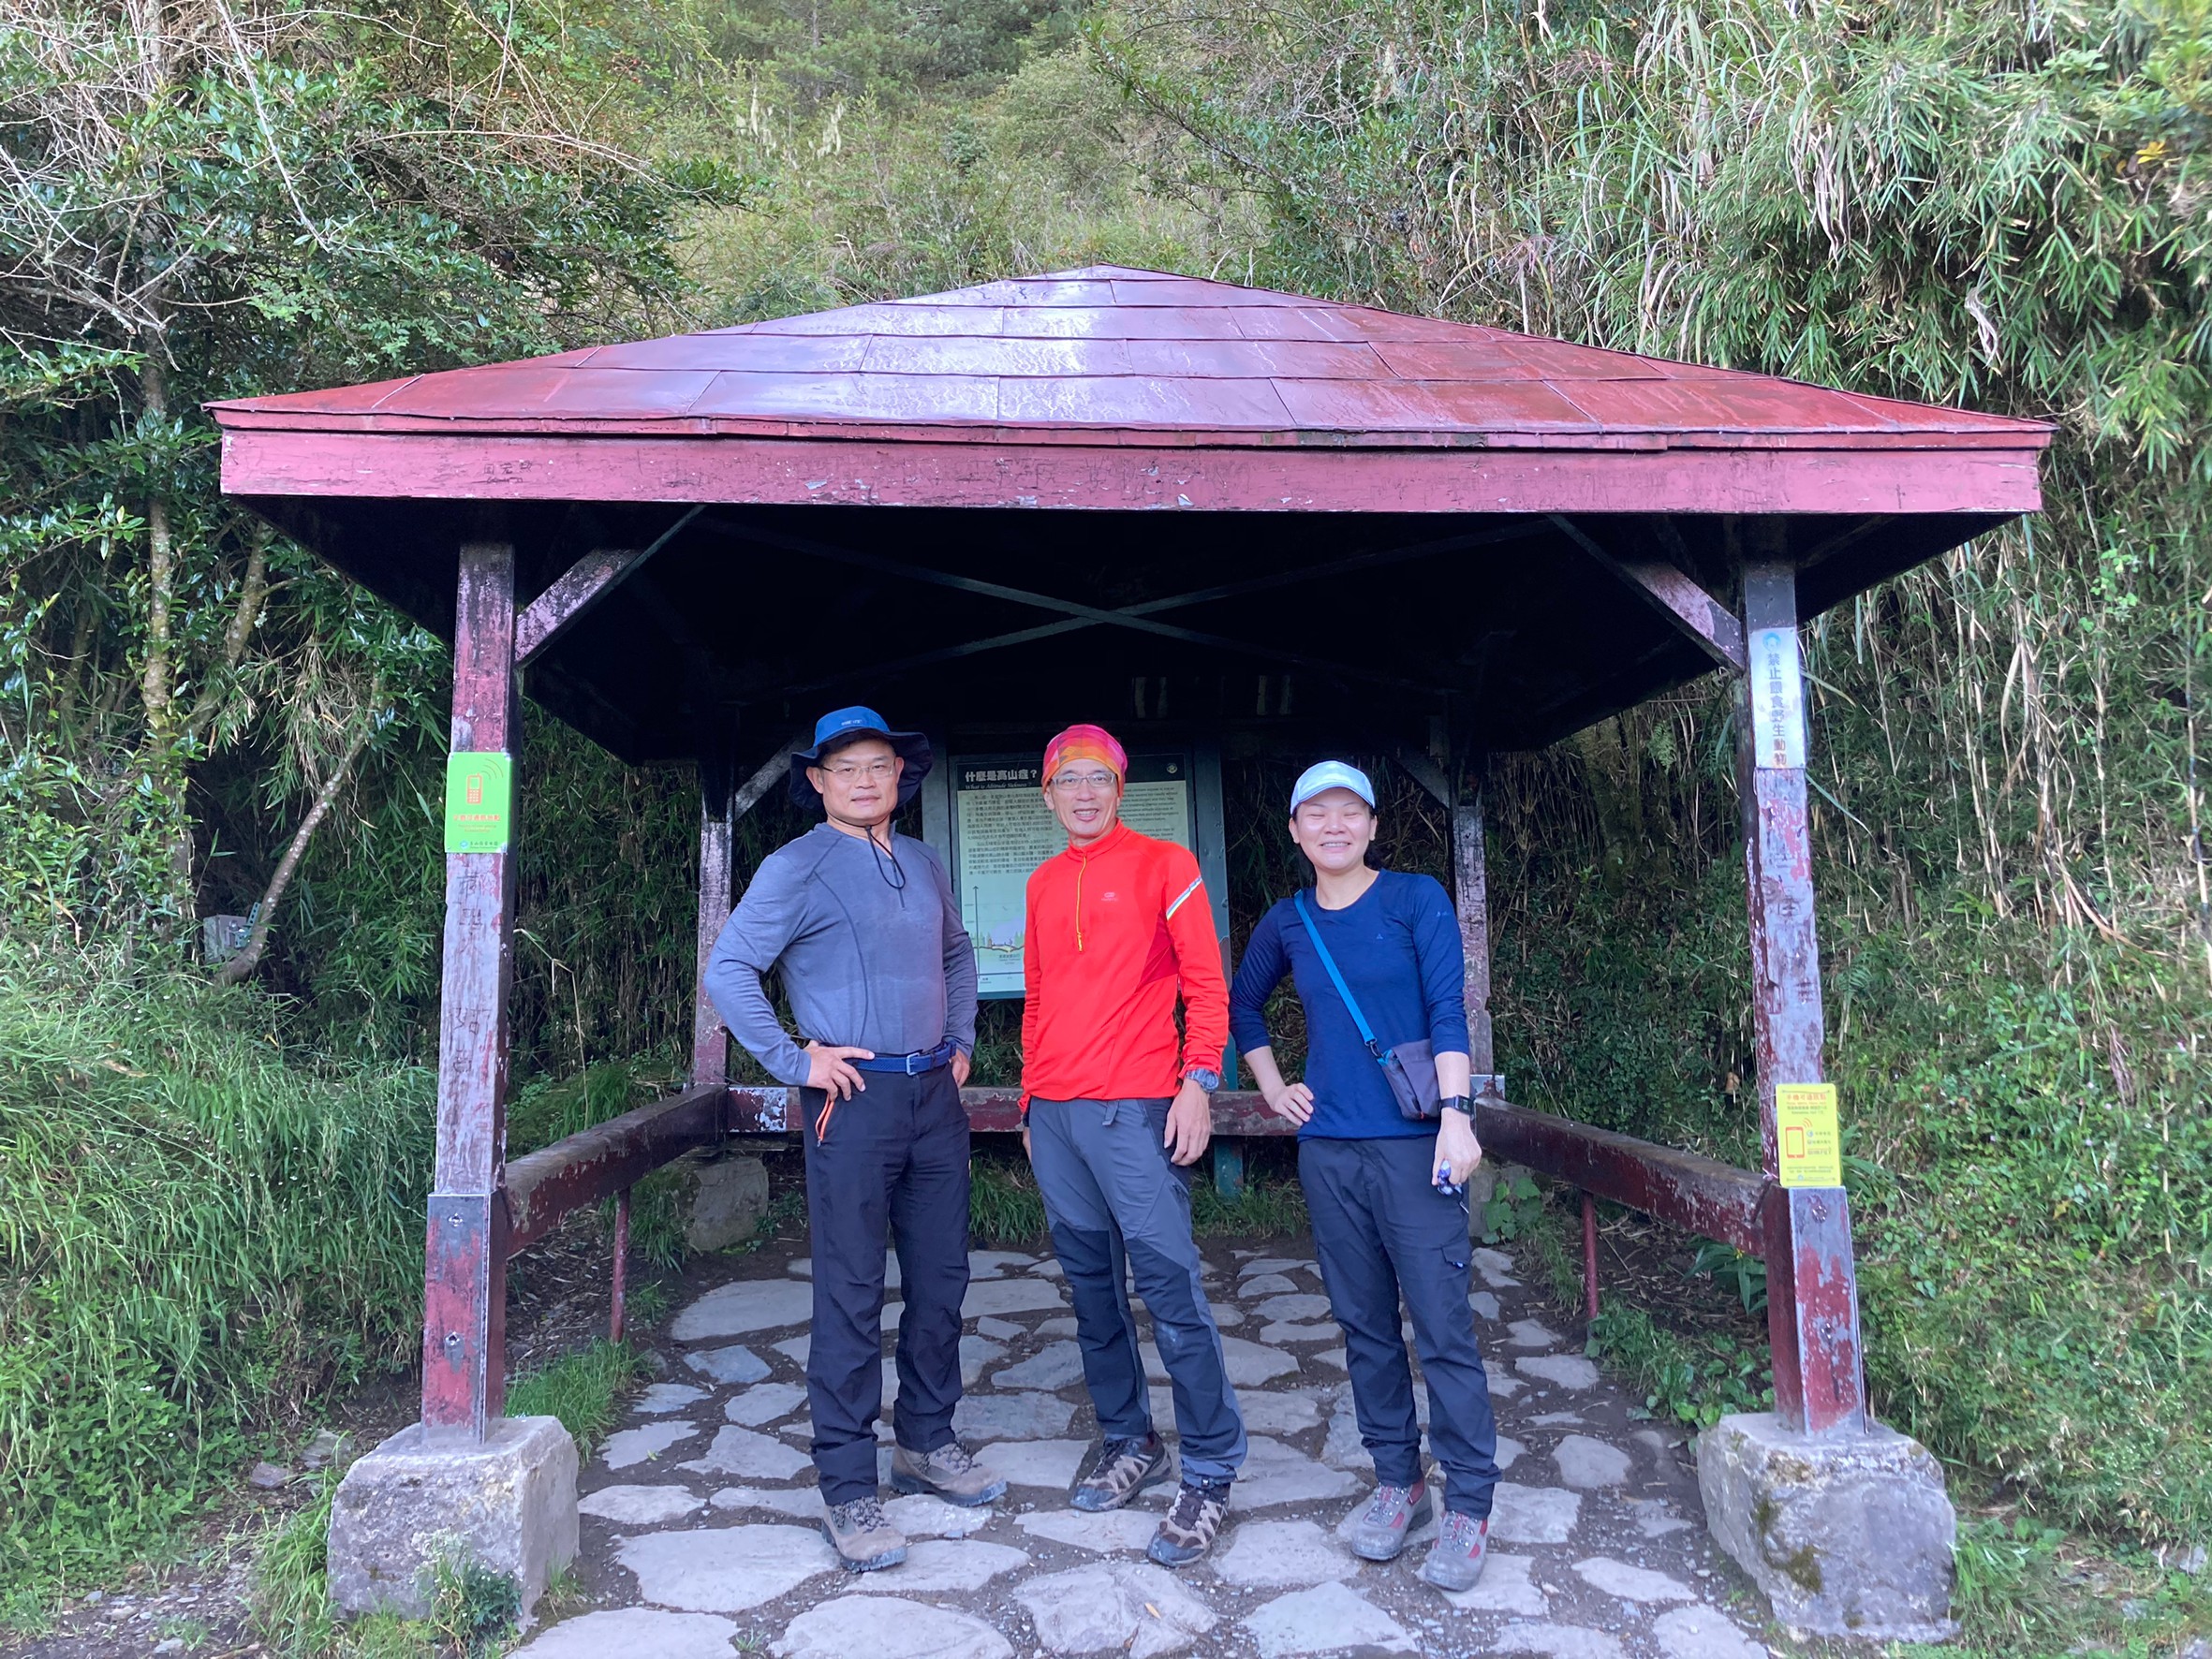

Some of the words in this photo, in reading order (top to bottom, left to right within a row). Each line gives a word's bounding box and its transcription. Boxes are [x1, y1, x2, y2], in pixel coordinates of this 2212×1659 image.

[1768, 653, 1787, 765] 禁止餵食野生動物
